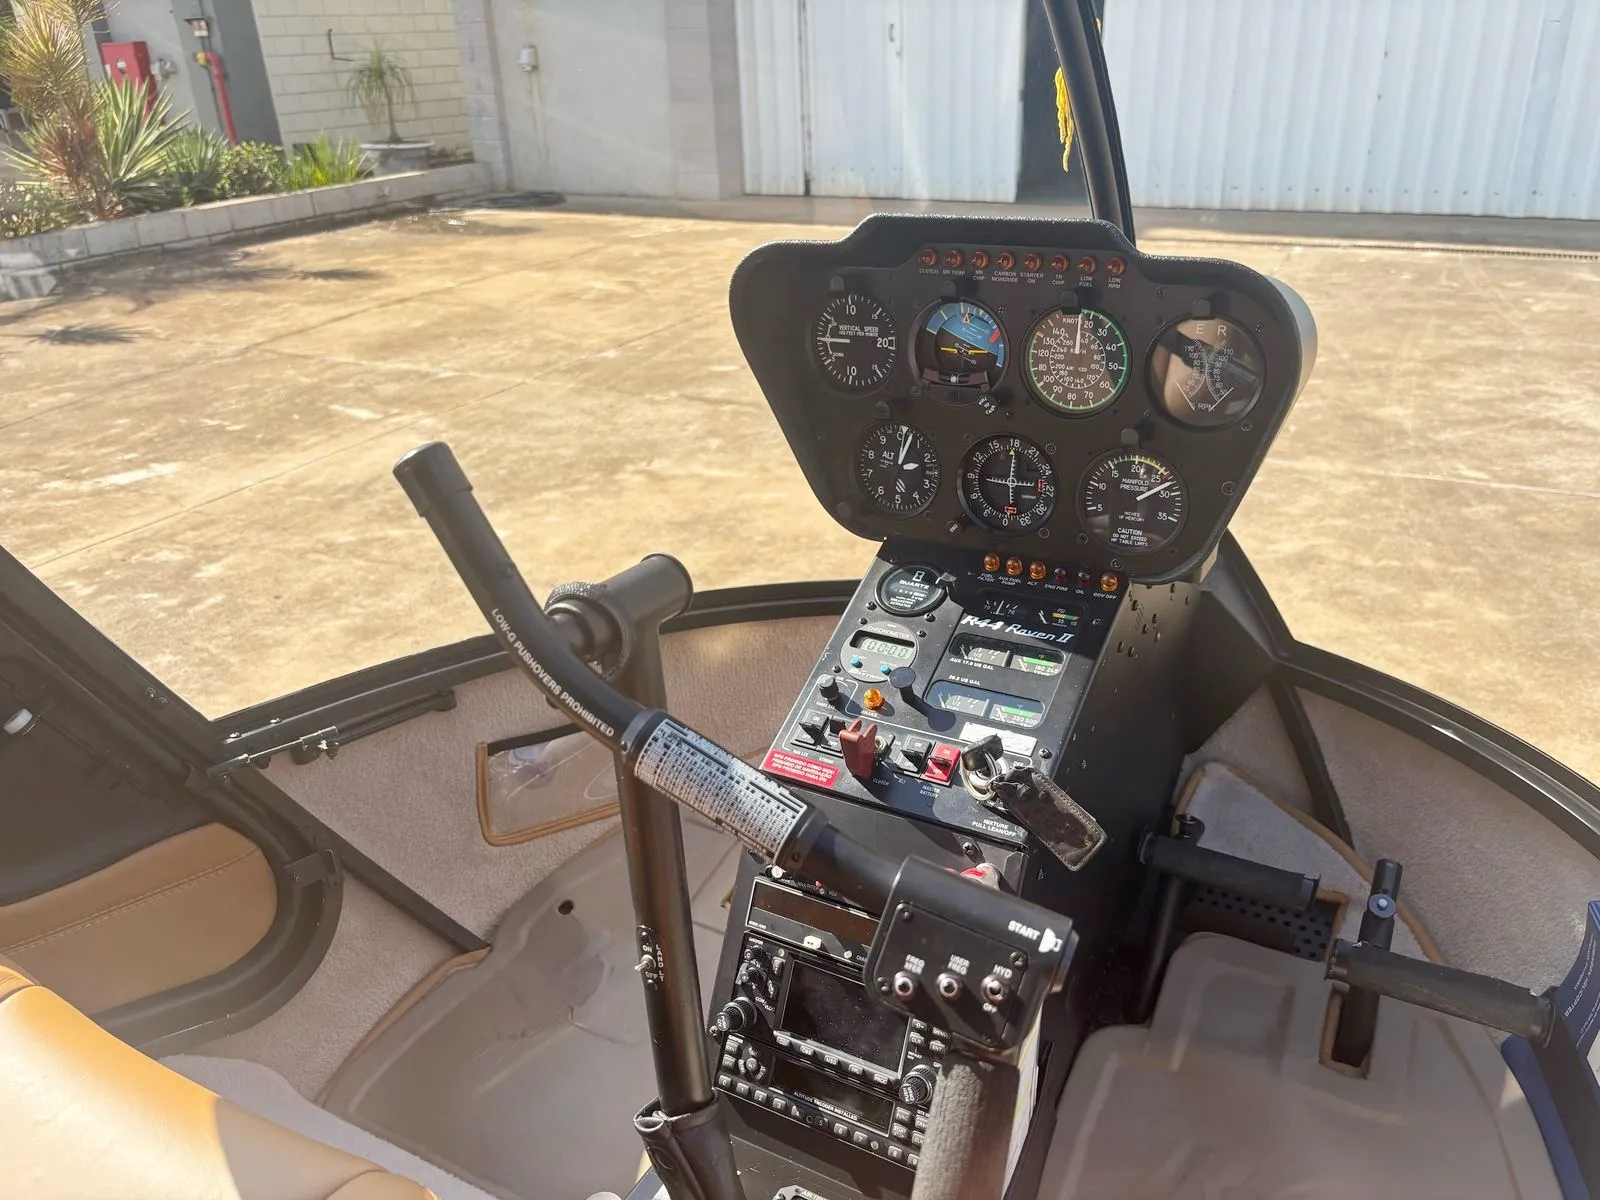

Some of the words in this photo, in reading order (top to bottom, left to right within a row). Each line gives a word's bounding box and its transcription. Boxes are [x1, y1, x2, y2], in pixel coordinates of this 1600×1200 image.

[846, 305, 856, 315] 10
[1084, 321, 1093, 329] 20
[1196, 324, 1204, 334] E
[1097, 328, 1107, 337] 30
[1217, 325, 1227, 336] R
[877, 338, 888, 347] 20
[847, 366, 857, 376] 10
[880, 436, 886, 444] 9
[989, 440, 1000, 450] 15
[1009, 439, 1020, 448] 18
[868, 450, 874, 459] 8
[882, 451, 894, 460] ALT
[1028, 446, 1040, 457] 21
[924, 453, 931, 462] 2
[973, 452, 984, 462] 12
[867, 469, 873, 477] 7
[1042, 463, 1052, 476] 24
[924, 480, 930, 488] 3
[1120, 484, 1148, 492] PRESSURE
[878, 486, 884, 495] 6
[1046, 485, 1054, 497] 27
[895, 495, 901, 504] 5
[1036, 504, 1047, 515] 30
[1020, 516, 1032, 526] 33
[1157, 512, 1167, 520] 35
[899, 580, 930, 589] QUARTZ
[867, 625, 910, 638] CHRONOMETER
[960, 615, 1005, 630] R44
[1005, 624, 1056, 642] Raven
[1056, 632, 1075, 643] II
[491, 608, 517, 642] LOW-G
[514, 641, 562, 695] PUSHOVERS
[560, 691, 615, 737] PROHIBITED
[805, 771, 818, 780] PARA
[873, 778, 890, 786] CLUTCH
[972, 821, 986, 829] PULL
[988, 826, 1017, 836] LEAN/OFF
[983, 819, 1009, 829] MIXTURE
[1008, 920, 1041, 941] START
[656, 944, 664, 968] LAND
[906, 954, 926, 966] FREQ
[950, 954, 970, 966] USER
[948, 961, 967, 976] FREQ
[993, 964, 1013, 979] HYD
[814, 1099, 834, 1111] ENCODER
[834, 1108, 858, 1120] INSTALLED
